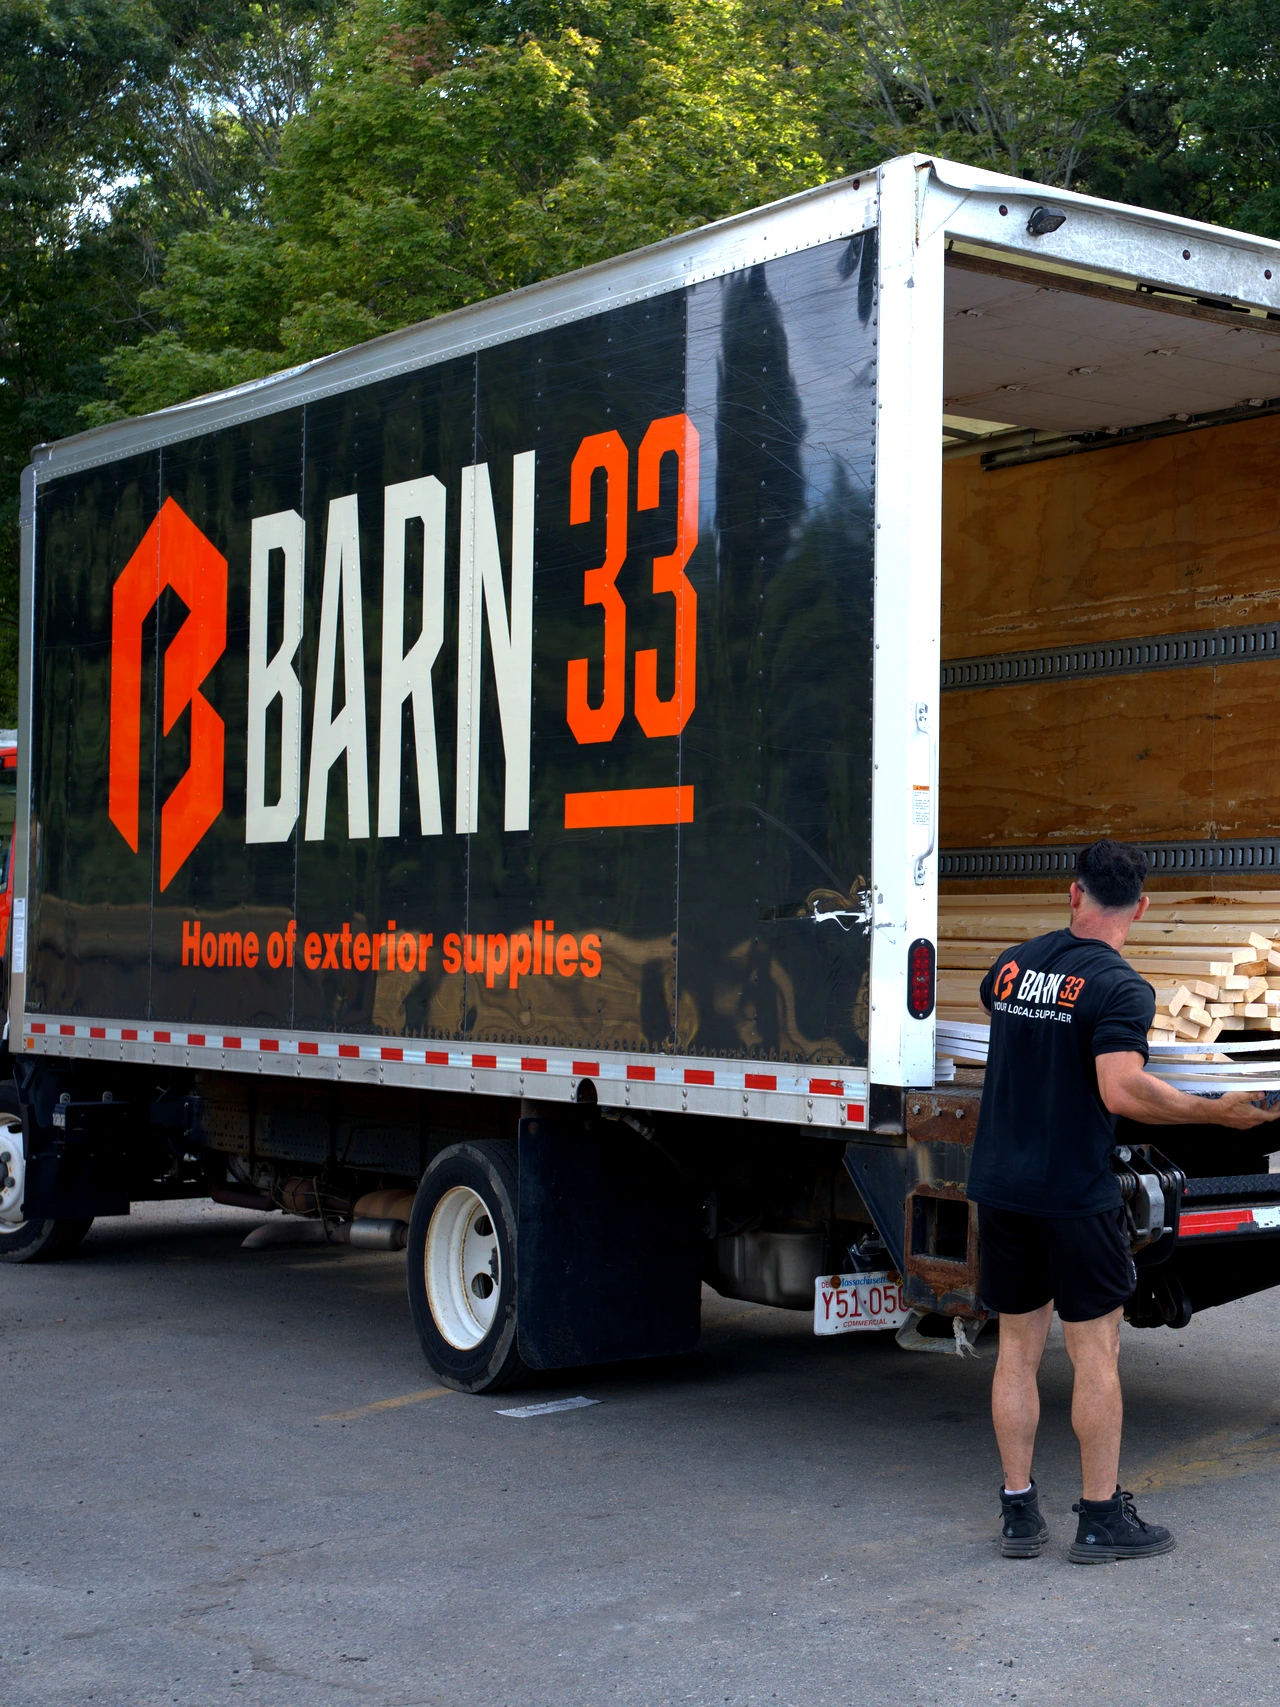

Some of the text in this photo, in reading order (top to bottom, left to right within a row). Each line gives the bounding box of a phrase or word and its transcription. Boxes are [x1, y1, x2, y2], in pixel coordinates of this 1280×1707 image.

[245, 450, 536, 845] BARN
[566, 413, 701, 745] 33
[181, 919, 602, 989] Home of exterior supplies
[1017, 969, 1065, 1004] BARN
[1059, 975, 1086, 1001] 33
[993, 1001, 1007, 1011] YOUR
[1007, 1004, 1034, 1018] LOCAL
[843, 1318, 888, 1328] COMMERCIAL
